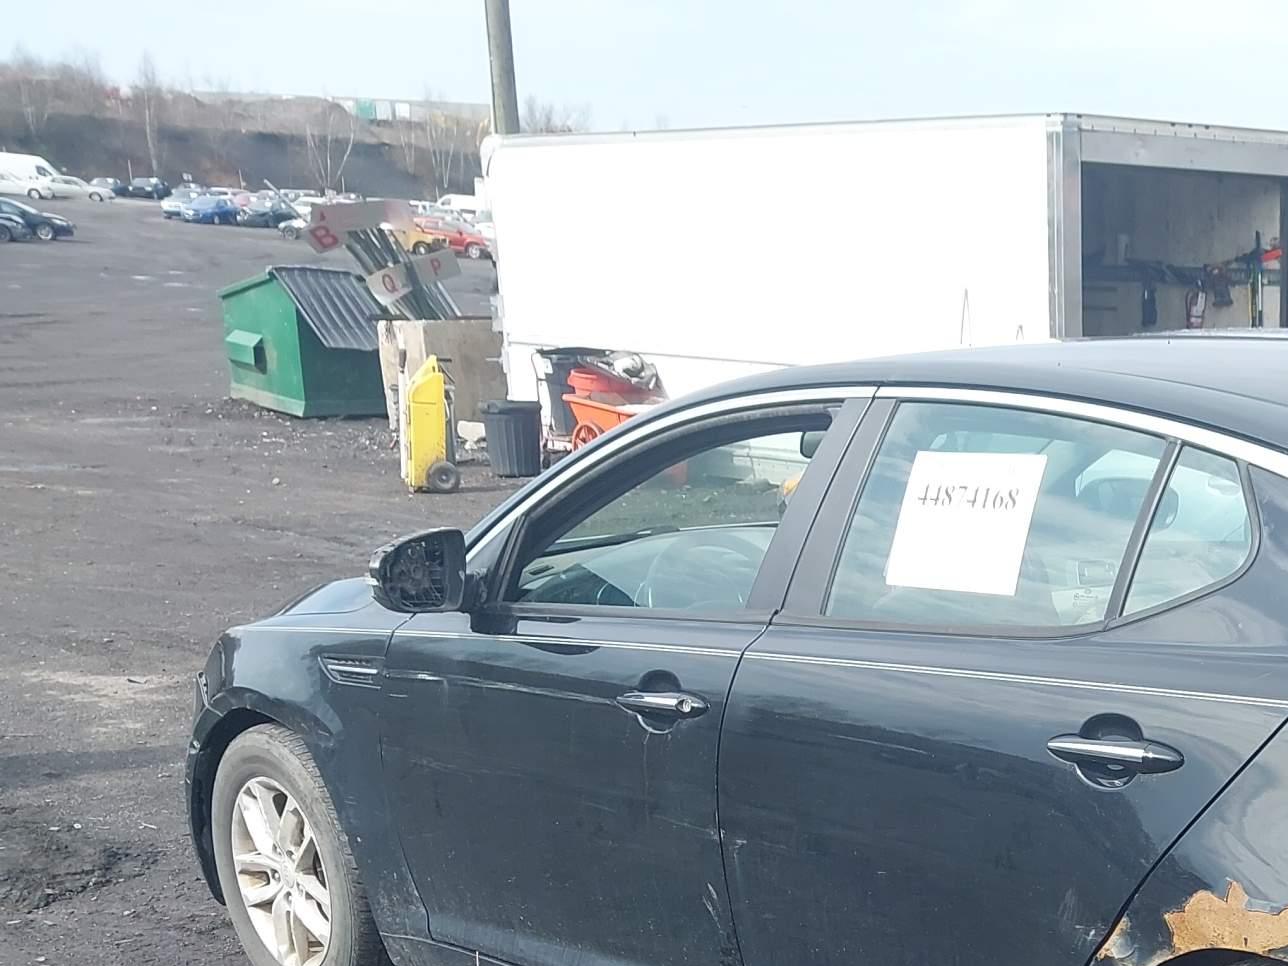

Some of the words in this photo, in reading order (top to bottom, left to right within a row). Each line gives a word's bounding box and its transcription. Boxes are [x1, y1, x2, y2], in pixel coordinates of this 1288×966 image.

[310, 226, 338, 248] B
[430, 258, 441, 276] P
[382, 273, 399, 294] Q
[917, 483, 1020, 510] 44874168
